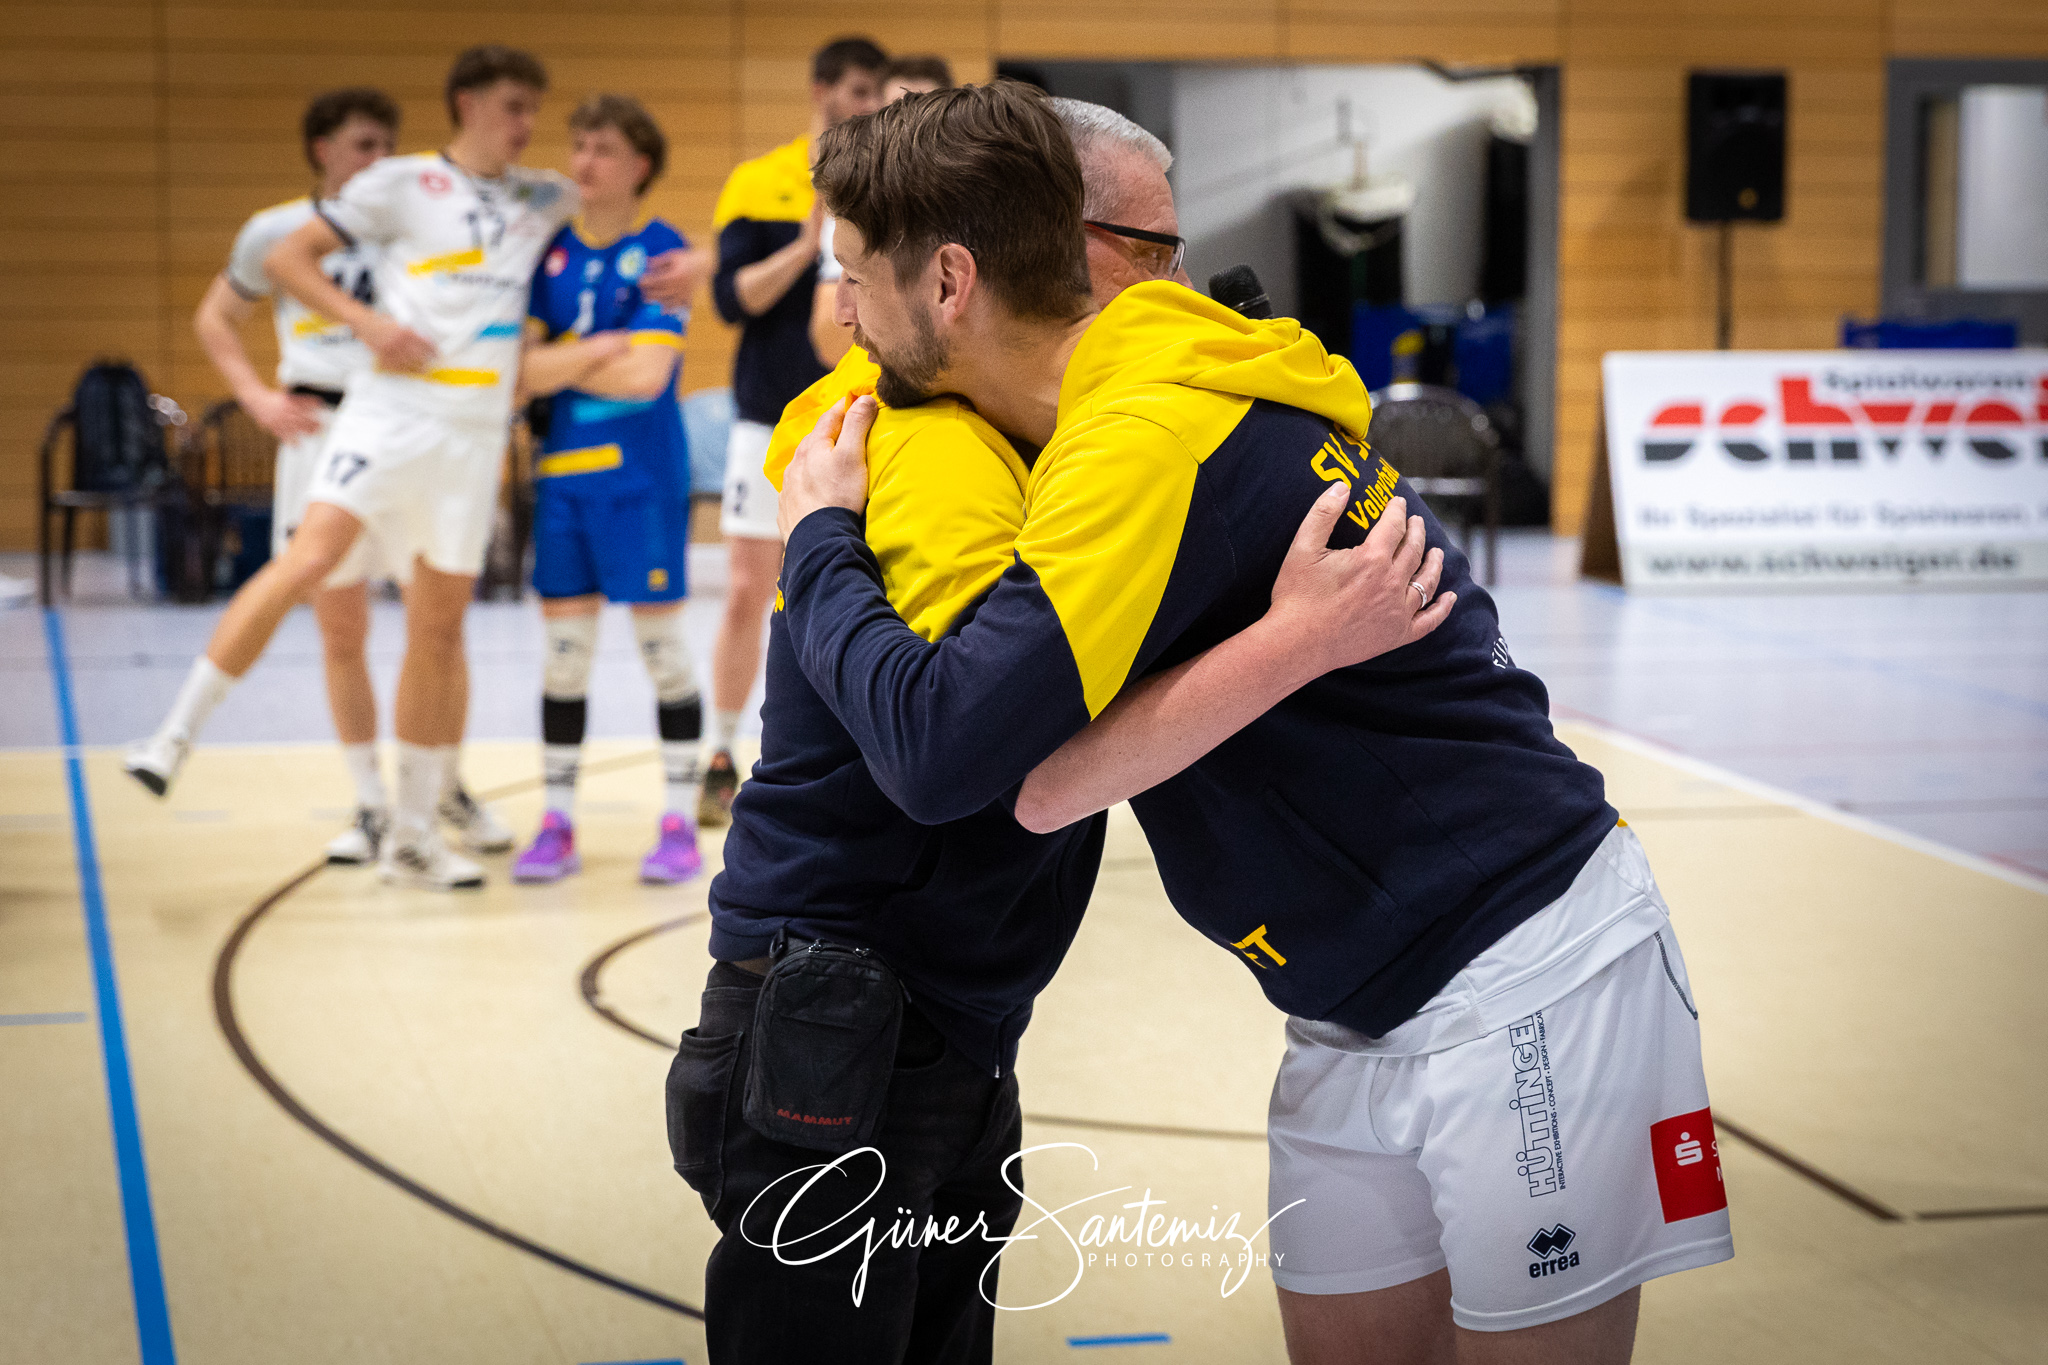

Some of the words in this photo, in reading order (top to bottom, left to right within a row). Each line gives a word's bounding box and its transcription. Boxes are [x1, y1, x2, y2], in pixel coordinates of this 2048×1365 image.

[1541, 1044, 1551, 1071] DESIGN
[1545, 1075, 1556, 1107] CONCEPT
[777, 1108, 853, 1126] MAMMUT
[1528, 1250, 1581, 1279] errea
